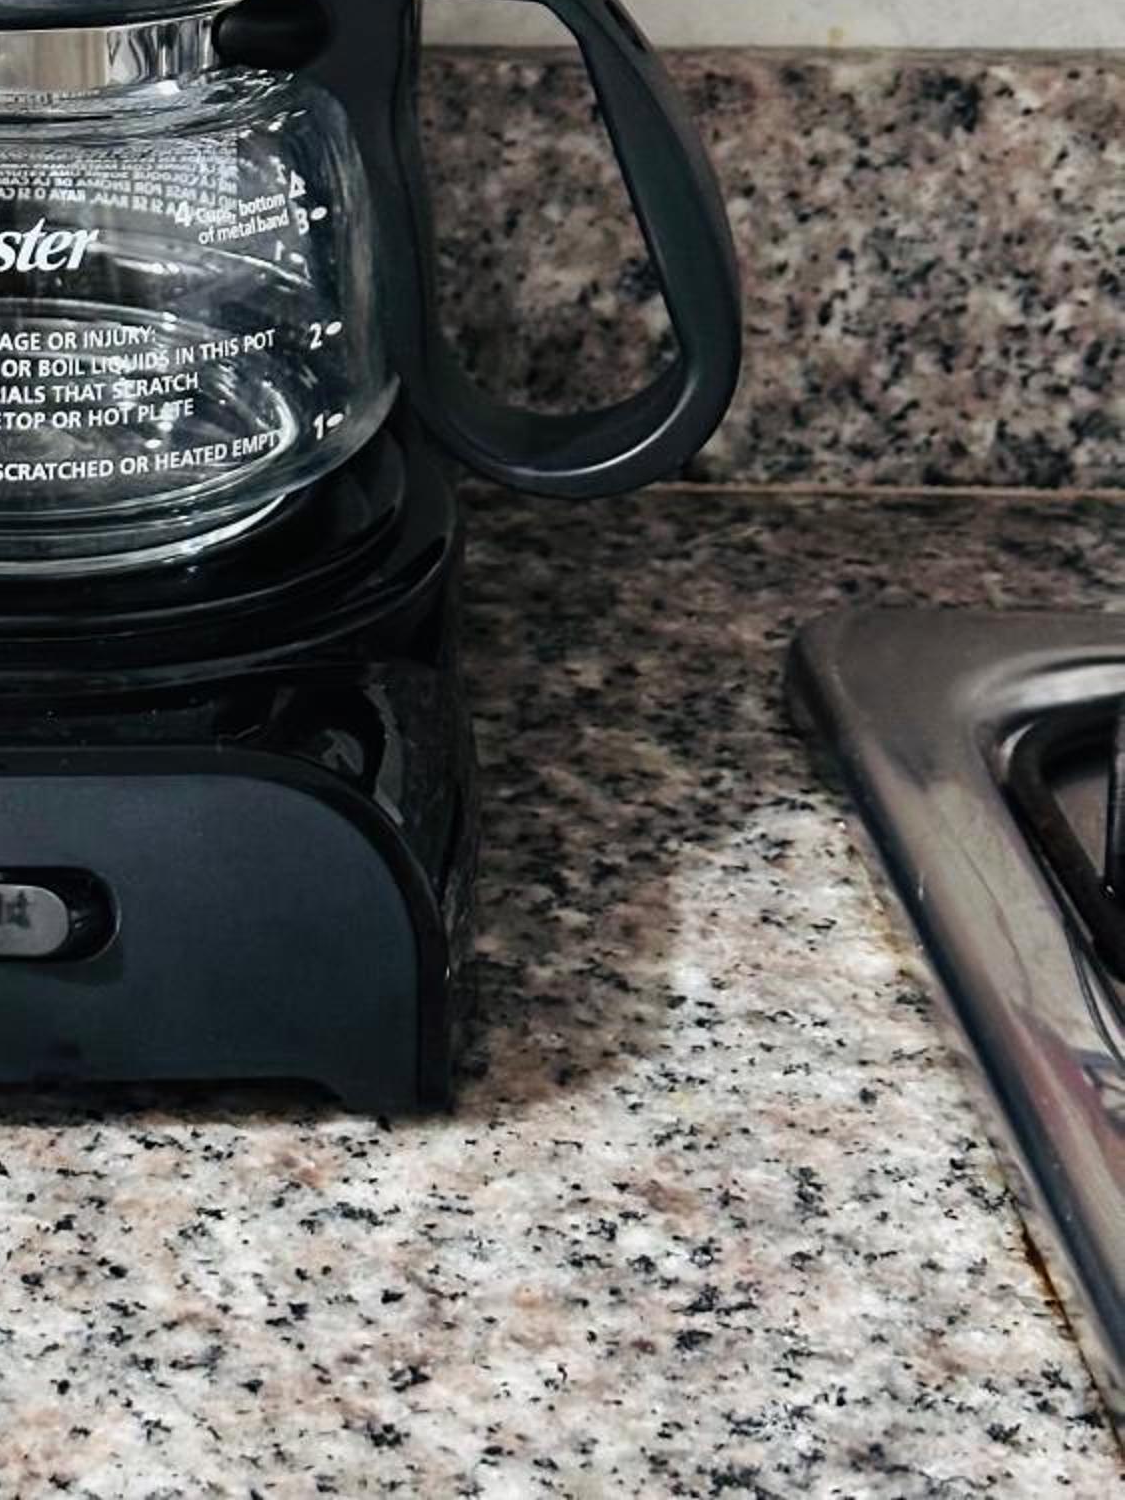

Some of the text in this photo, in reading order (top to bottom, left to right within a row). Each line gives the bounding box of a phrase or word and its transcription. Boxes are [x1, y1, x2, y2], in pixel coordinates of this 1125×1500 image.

[238, 193, 286, 216] bottom
[198, 206, 290, 245] of metal band
[48, 332, 78, 350] OR
[83, 325, 156, 349] INJURY:
[309, 321, 323, 351] 2
[1, 358, 32, 377] OR
[38, 357, 86, 377] BOIL
[91, 350, 170, 376] LIQUIDS
[175, 345, 195, 366] IN
[199, 338, 240, 361] THIS
[243, 328, 276, 354] POT
[53, 382, 106, 403] THAT
[112, 372, 198, 400] SCRATCH
[52, 409, 83, 430] OR
[88, 400, 131, 428] HOT
[137, 397, 196, 424] PLATE
[313, 413, 324, 441] 1
[120, 456, 150, 478] OR
[154, 439, 227, 469] HEATED
